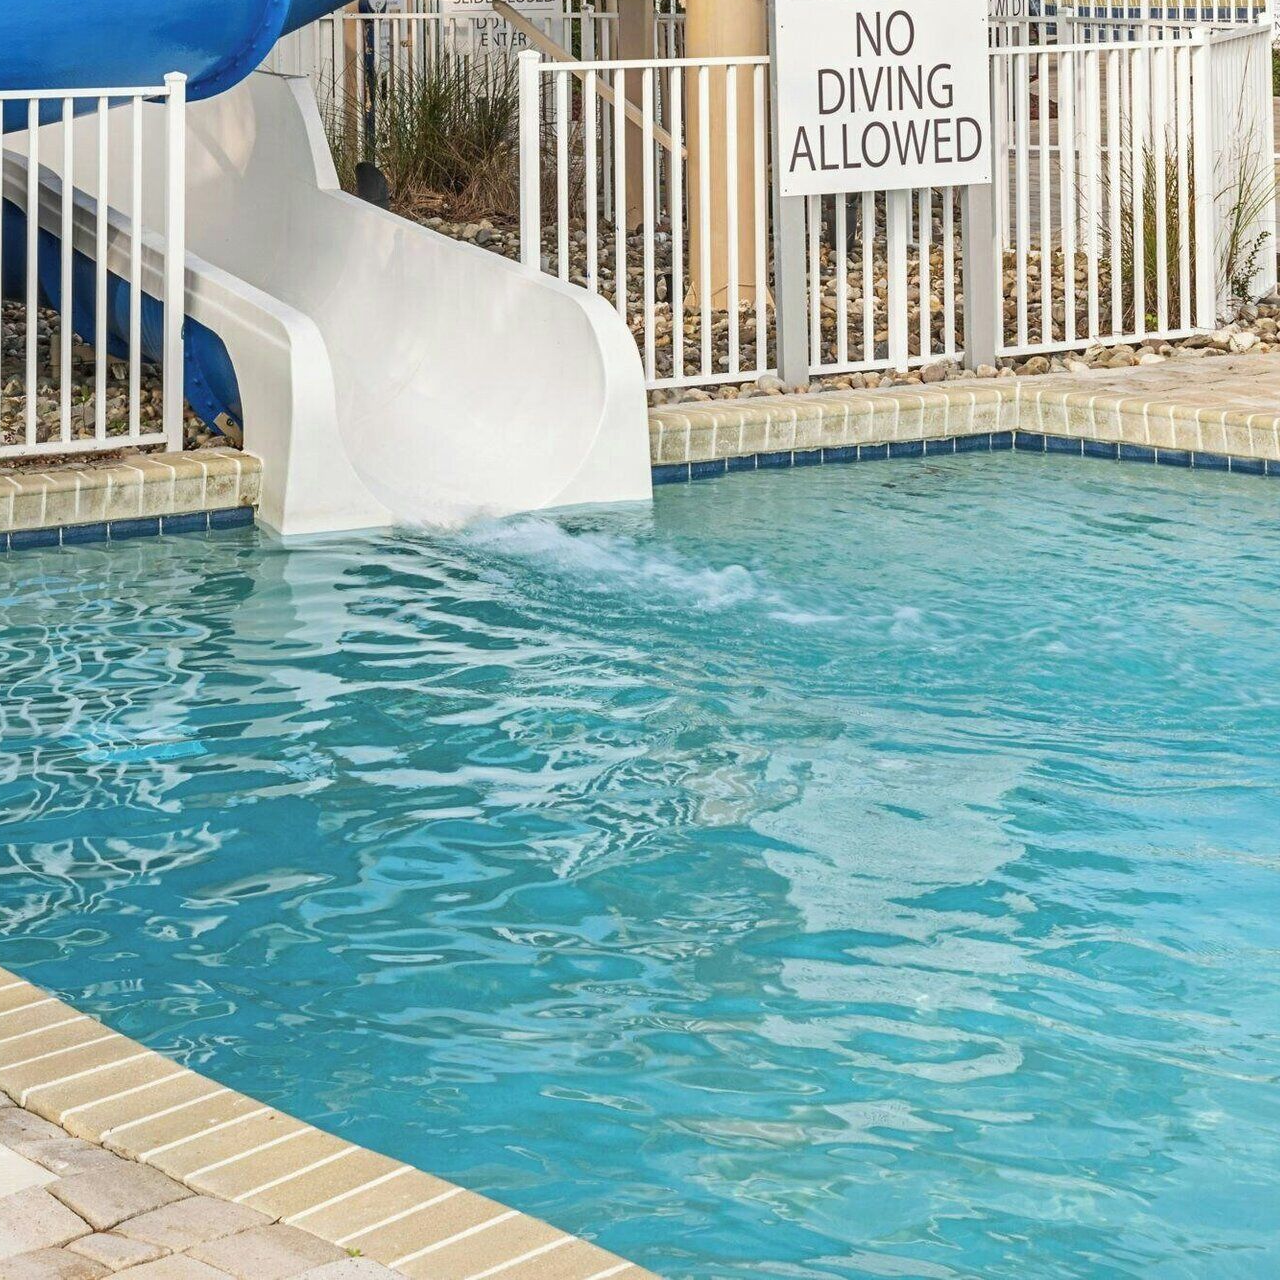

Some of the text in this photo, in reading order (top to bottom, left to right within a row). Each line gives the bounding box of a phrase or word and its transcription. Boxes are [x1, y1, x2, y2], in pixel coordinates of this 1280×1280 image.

[856, 10, 915, 57] NO
[818, 63, 954, 115] DIVING
[789, 117, 982, 172] ALLOWED
